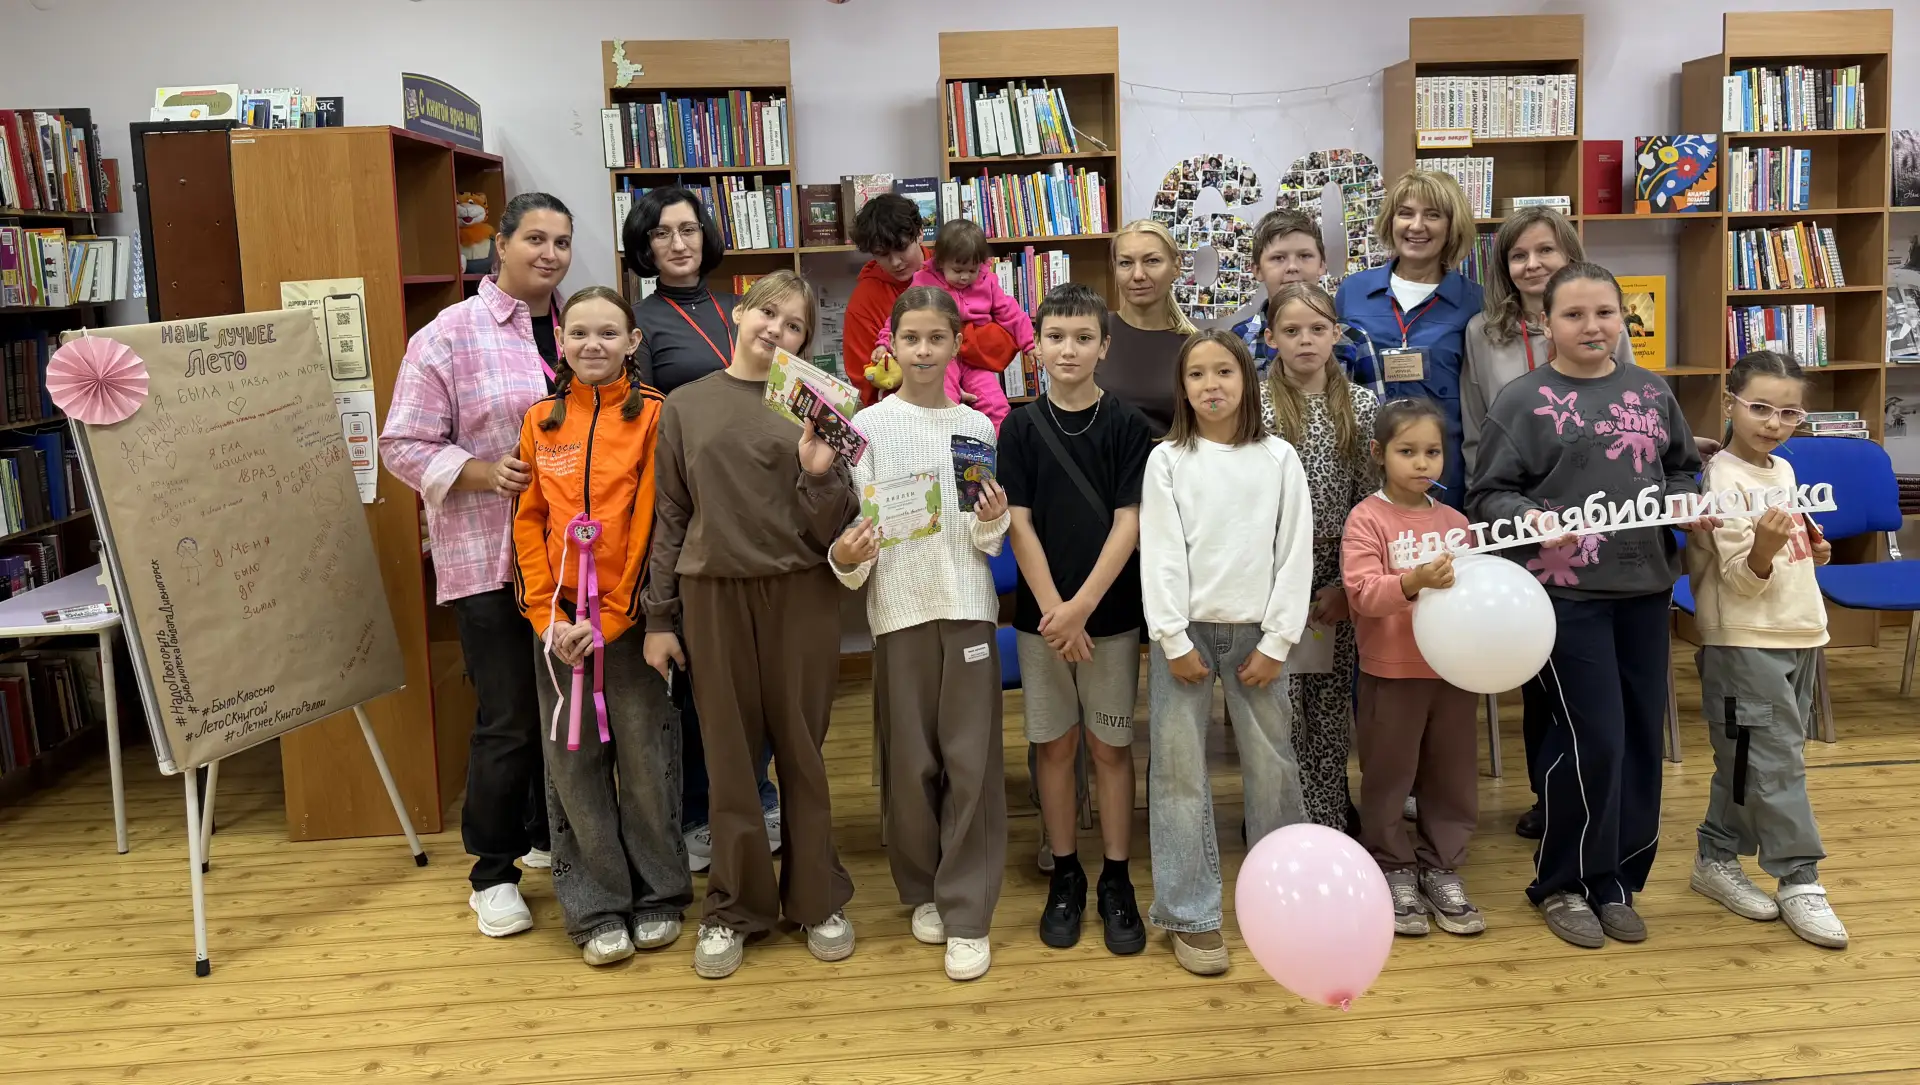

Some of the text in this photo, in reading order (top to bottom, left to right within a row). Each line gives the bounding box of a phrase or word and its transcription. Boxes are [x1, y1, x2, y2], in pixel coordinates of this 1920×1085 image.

[419, 89, 480, 137] С книгой ярче мир!
[608, 123, 618, 167] Краеведение
[685, 113, 694, 154] СОЗИДАТЕЛИ
[214, 324, 276, 348] ЛУЧШЕЕ
[155, 395, 164, 414] Я
[177, 384, 221, 404] БЫЛА
[241, 376, 268, 388] РАЗА
[277, 371, 290, 380] НА
[298, 364, 326, 376] МОРЕ
[128, 459, 139, 474] В
[209, 448, 215, 460] Я
[1396, 483, 1834, 562] #детскаябиблиотека
[230, 536, 270, 559] МЕНЯ
[234, 563, 260, 581] БЫЛО
[202, 685, 275, 716] #БылоКлассно
[185, 702, 268, 741] #ЛетоСКнигой
[1096, 712, 1131, 728] ARVAR
